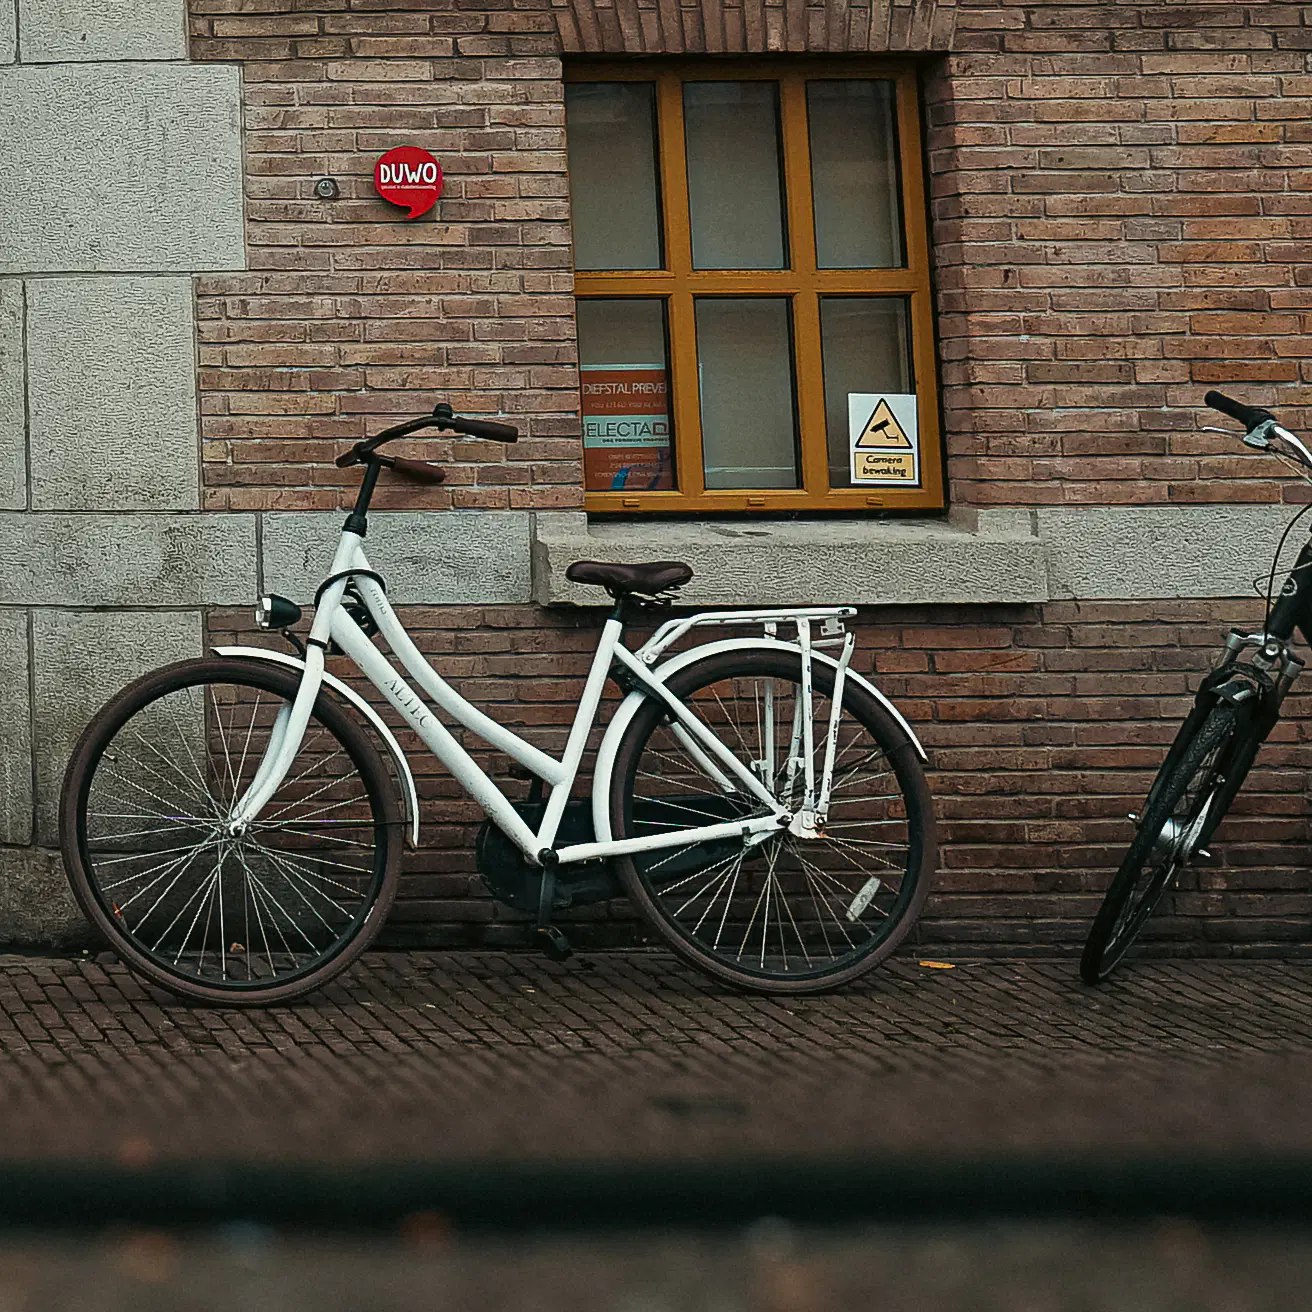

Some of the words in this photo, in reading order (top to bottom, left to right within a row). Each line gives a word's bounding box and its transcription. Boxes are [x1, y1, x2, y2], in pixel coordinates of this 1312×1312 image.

[380, 162, 437, 184] DUWO
[866, 455, 903, 464] Camera
[863, 466, 906, 477] bewaking
